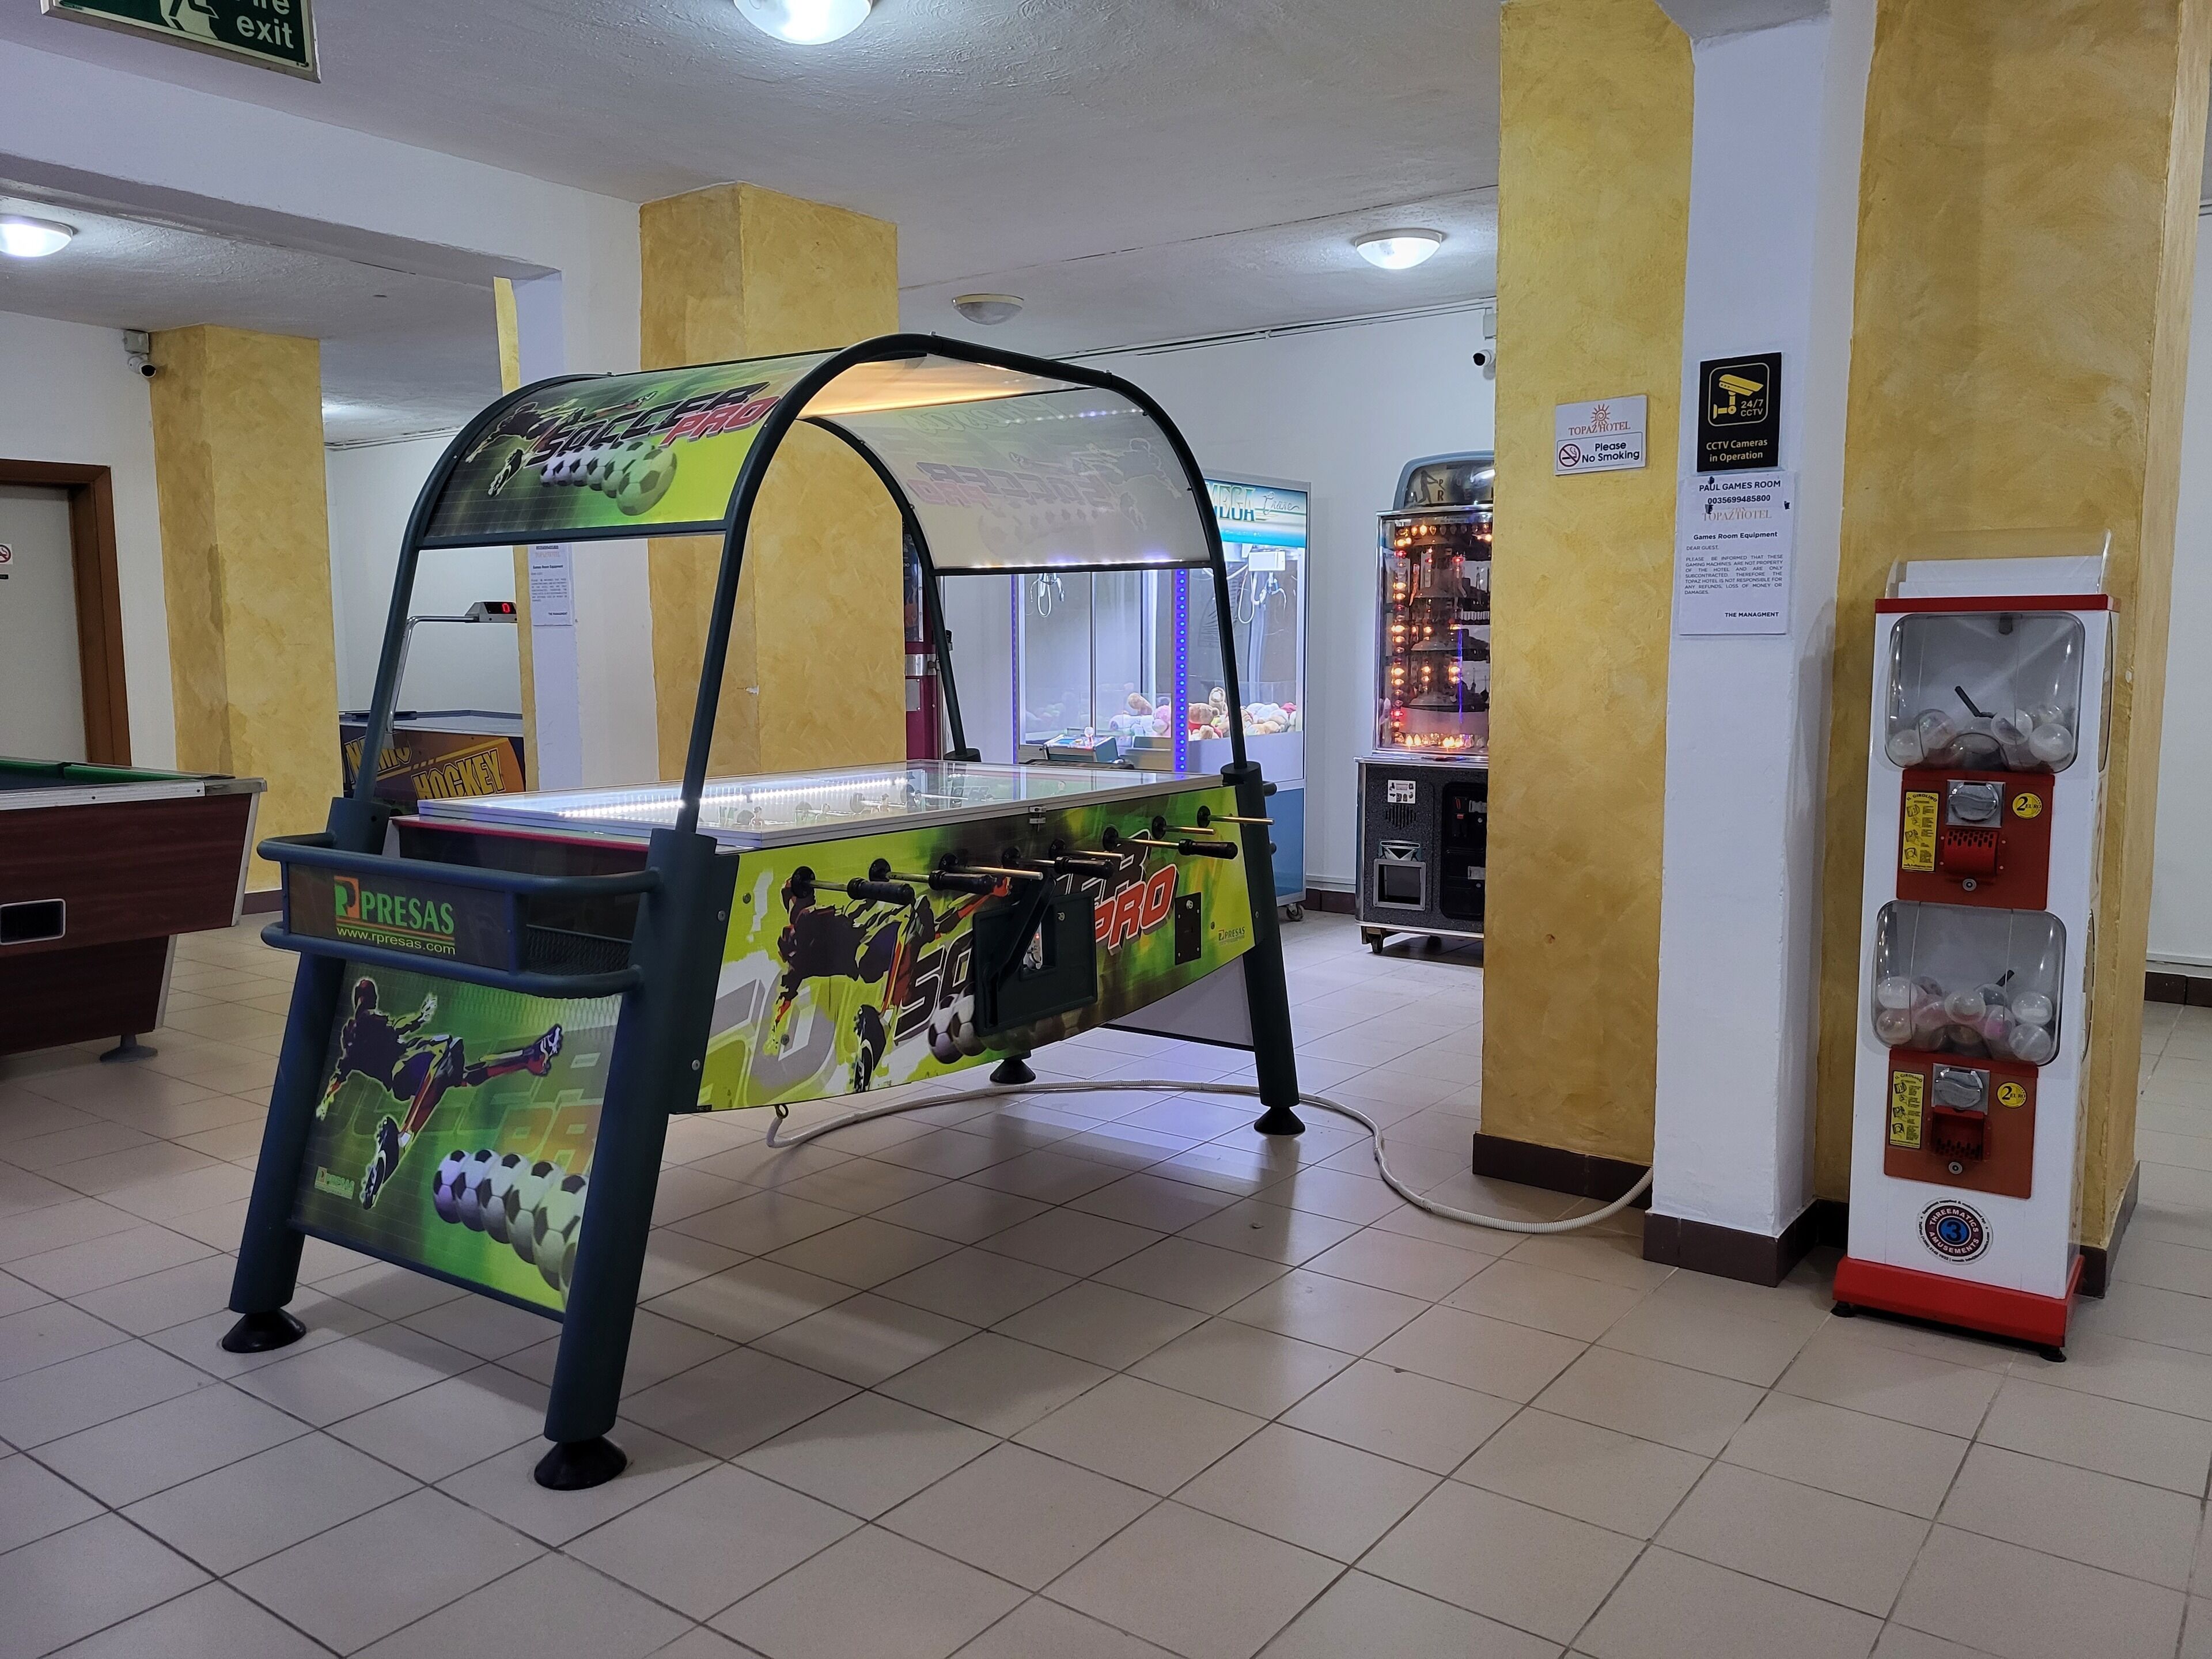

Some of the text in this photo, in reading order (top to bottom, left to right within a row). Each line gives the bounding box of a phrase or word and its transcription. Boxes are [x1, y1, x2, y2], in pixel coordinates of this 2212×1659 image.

[236, 15, 294, 49] exit
[1741, 399, 1764, 408] 24/7
[1740, 408, 1763, 416] CCTV
[524, 381, 770, 468] SOCCER
[658, 396, 782, 448] PRO
[1568, 421, 1631, 435] TOPAZ HOTEL
[1594, 442, 1627, 452] Please
[1706, 439, 1768, 450] CCTV Cameras
[1582, 450, 1640, 463] No Smoking
[1710, 450, 1763, 463] in Operation
[1699, 480, 1781, 491] PAUL GAMES ROOM
[1707, 494, 1771, 504] 0035699485800
[1740, 531, 1778, 539] Equipment
[502, 603, 510, 613] 0
[411, 748, 506, 800] HOCKEY
[2017, 796, 2028, 811] 2
[361, 891, 454, 934] PRESAS
[1094, 863, 1177, 953] PRO
[1225, 926, 1245, 939] PRESAS
[336, 927, 456, 955] www.rpresas.com
[2002, 1086, 2012, 1100] 2
[1929, 1209, 1979, 1233] THREEMATICS
[1946, 1219, 1961, 1243] 3
[1929, 1232, 1979, 1254] AMUSEMENTS
